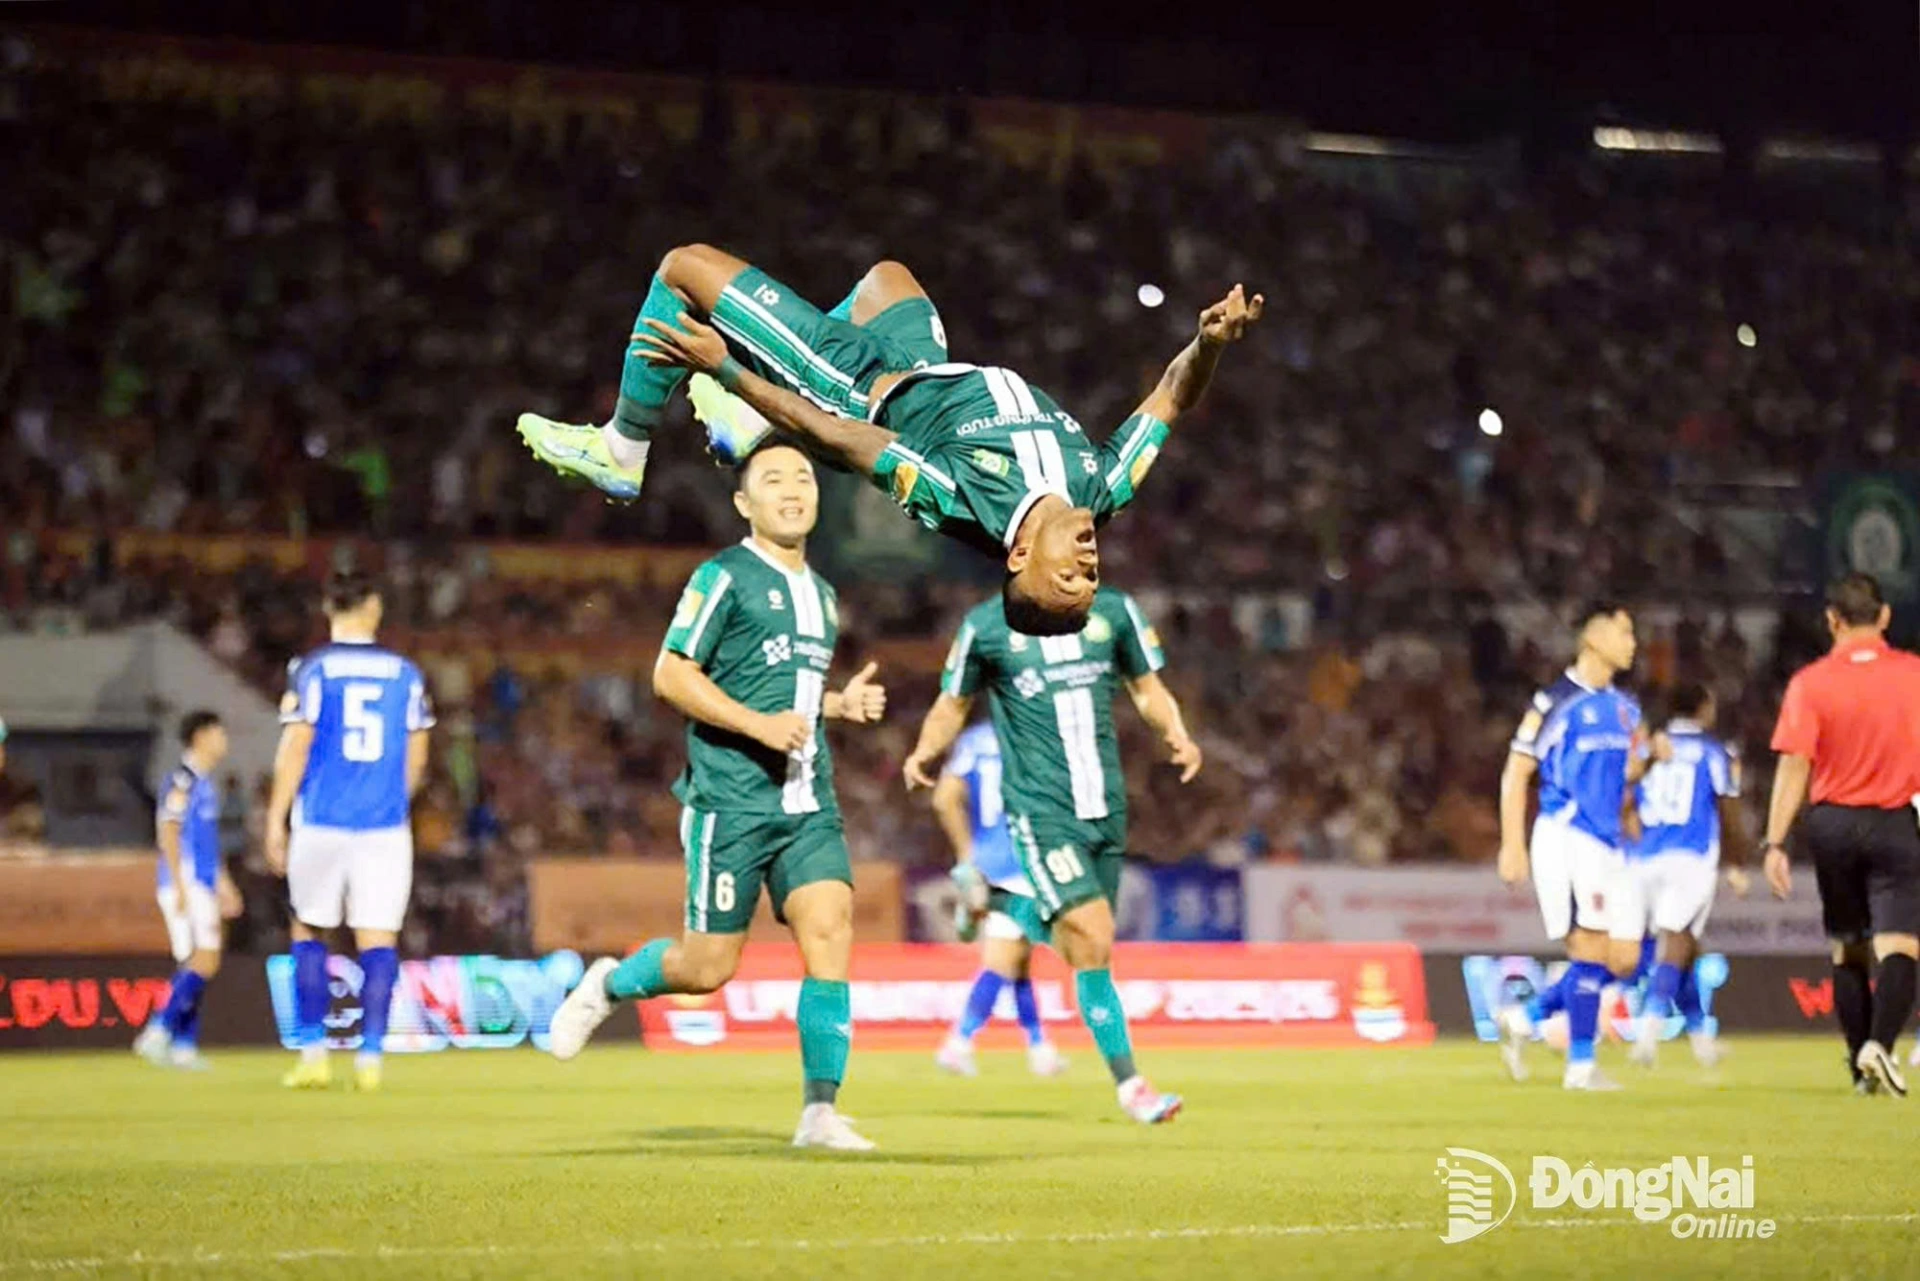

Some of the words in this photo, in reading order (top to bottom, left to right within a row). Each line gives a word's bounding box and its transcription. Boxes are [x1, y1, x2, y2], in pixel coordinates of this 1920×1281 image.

[343, 682, 384, 762] 5
[1046, 843, 1084, 884] 91
[715, 871, 736, 911] 6
